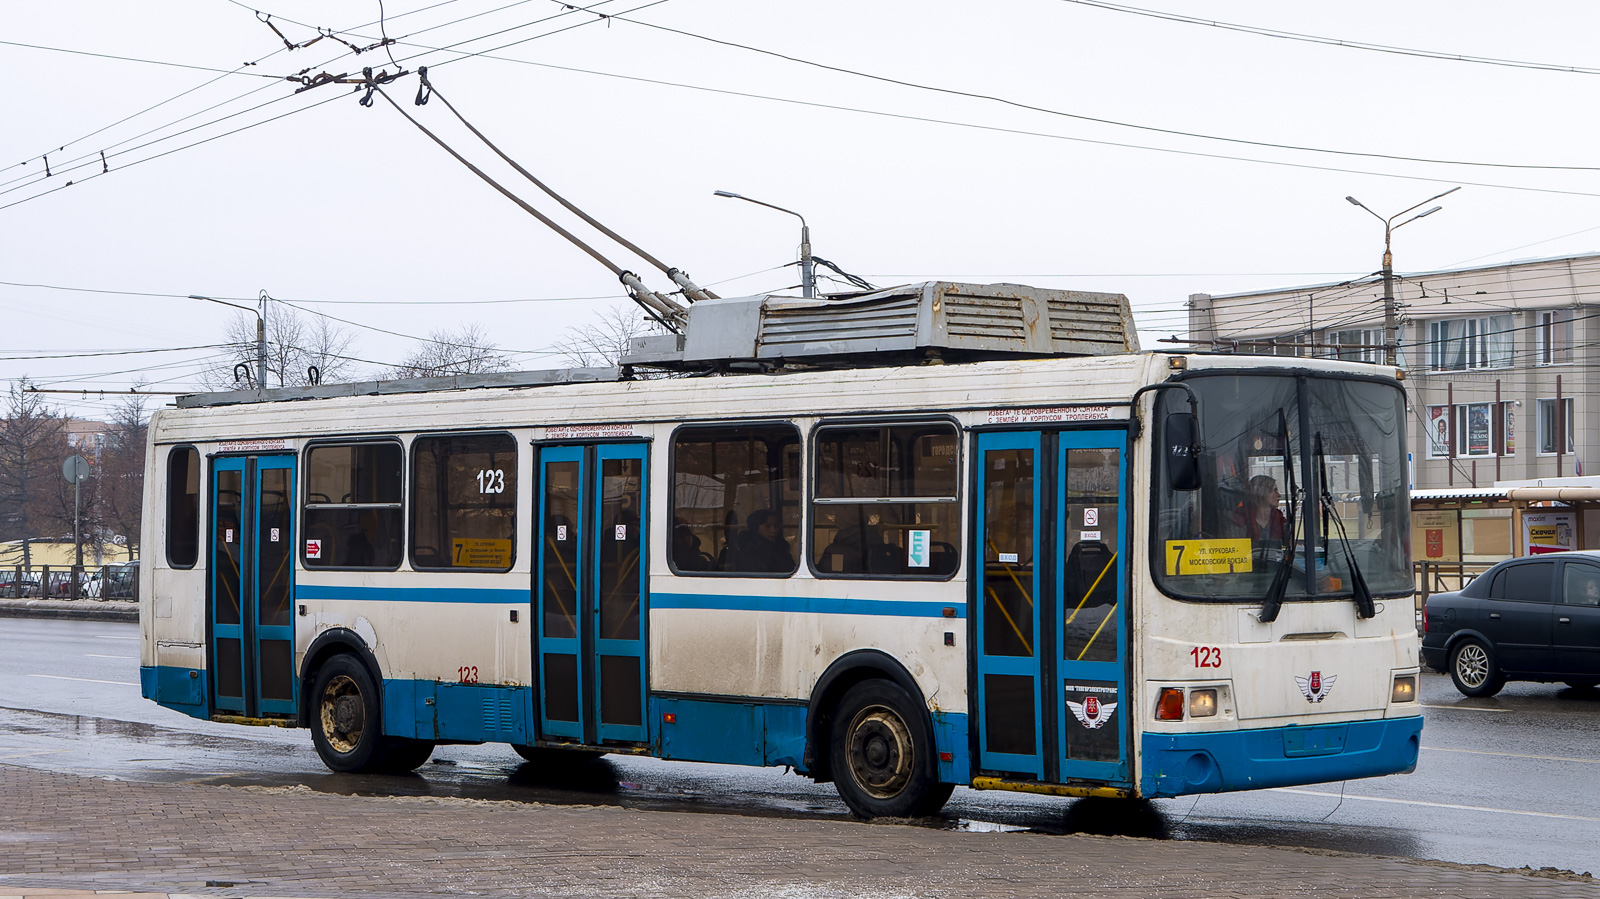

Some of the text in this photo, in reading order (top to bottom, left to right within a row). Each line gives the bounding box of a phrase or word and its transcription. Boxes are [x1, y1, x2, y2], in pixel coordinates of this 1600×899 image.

[1066, 412, 1108, 420] ТРОЛЛЕЙБУСА
[476, 469, 505, 494] 123
[455, 544, 463, 563] 7
[1173, 546, 1185, 575] 7
[1208, 547, 1236, 555] КУРКОВАЯ
[1189, 557, 1248, 566] МОСКОВСКИЙ ВОКЗАЛ
[1190, 646, 1222, 668] 123
[457, 665, 479, 684] 123
